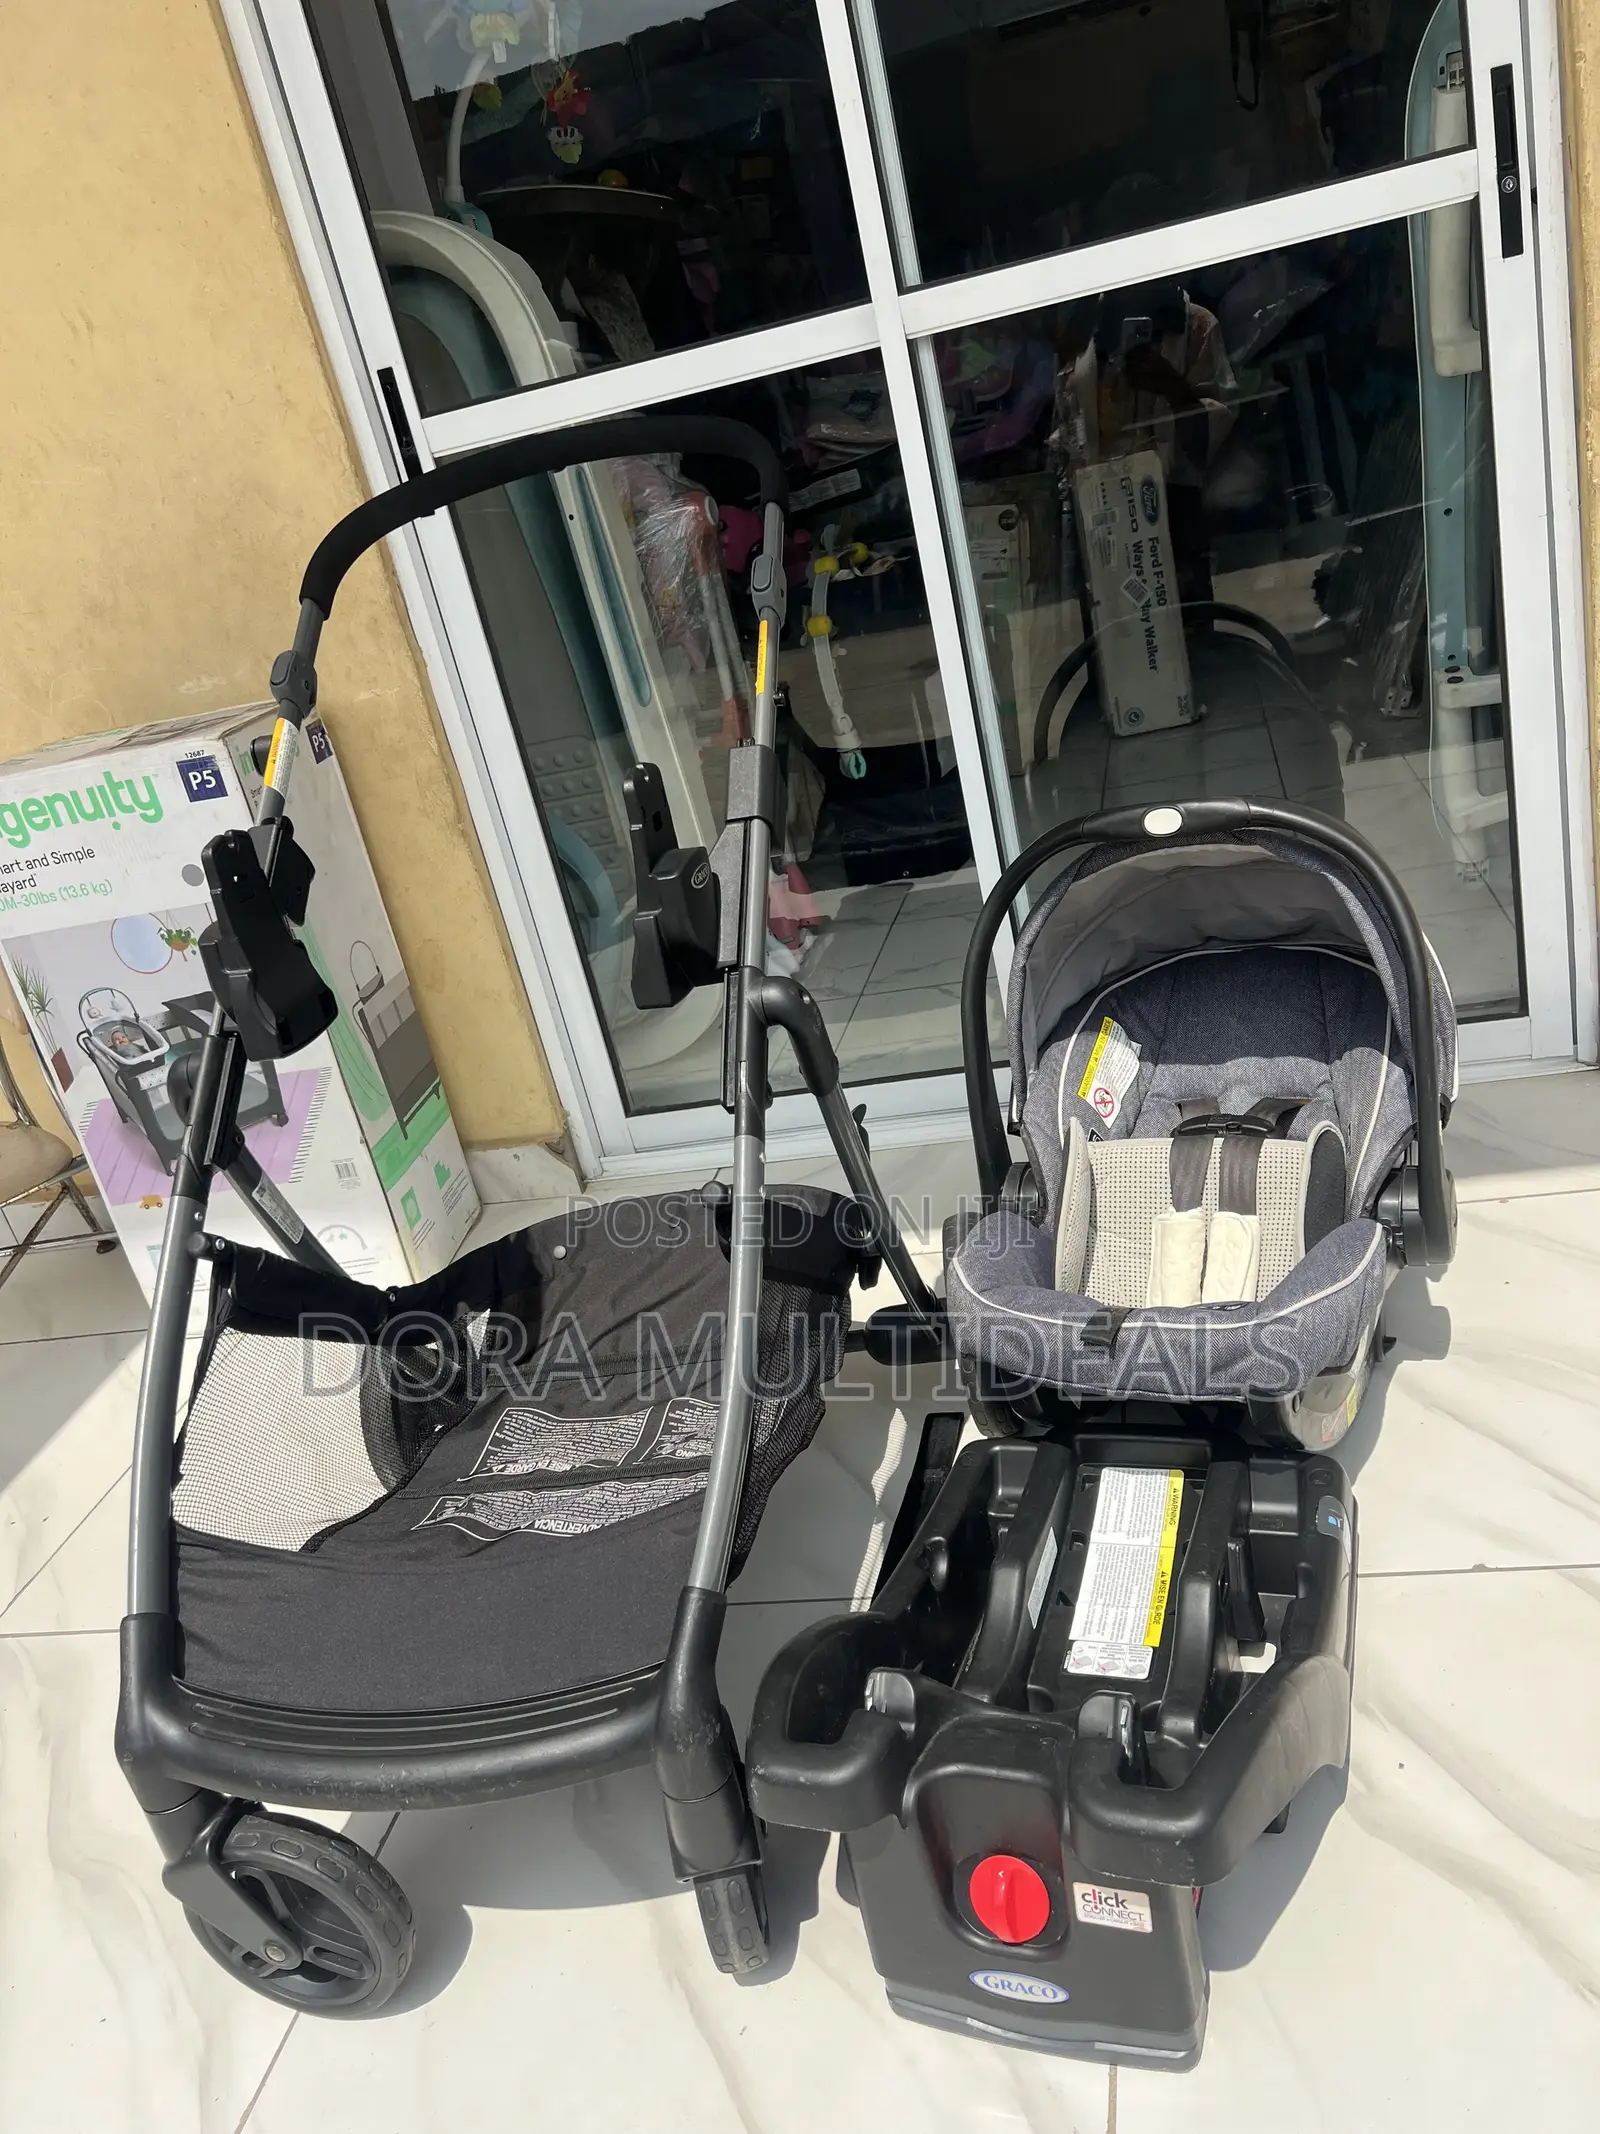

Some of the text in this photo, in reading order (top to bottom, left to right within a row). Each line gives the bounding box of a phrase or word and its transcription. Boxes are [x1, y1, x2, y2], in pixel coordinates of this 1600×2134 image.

[1148, 536, 1167, 607] Ford F-150
[1131, 539, 1145, 577] Ways
[1143, 625, 1159, 672] Walker
[312, 732, 326, 752] P5
[184, 749, 205, 759] 12687
[187, 769, 217, 791] P5
[0, 771, 164, 849] genuity
[25, 853, 50, 870] and
[51, 846, 96, 865] Simple
[0, 874, 37, 895] ayard
[59, 883, 89, 901] (13.6
[90, 878, 113, 897] kg)
[505, 1462, 534, 1473] GARDE
[548, 1460, 573, 1472] MISE
[1169, 1493, 1180, 1525] WARNING
[1159, 1580, 1167, 1595] MISE
[1081, 1888, 1129, 1910] click
[1082, 1904, 1145, 1922] CONNECT
[983, 1974, 1058, 2000] GRACO
